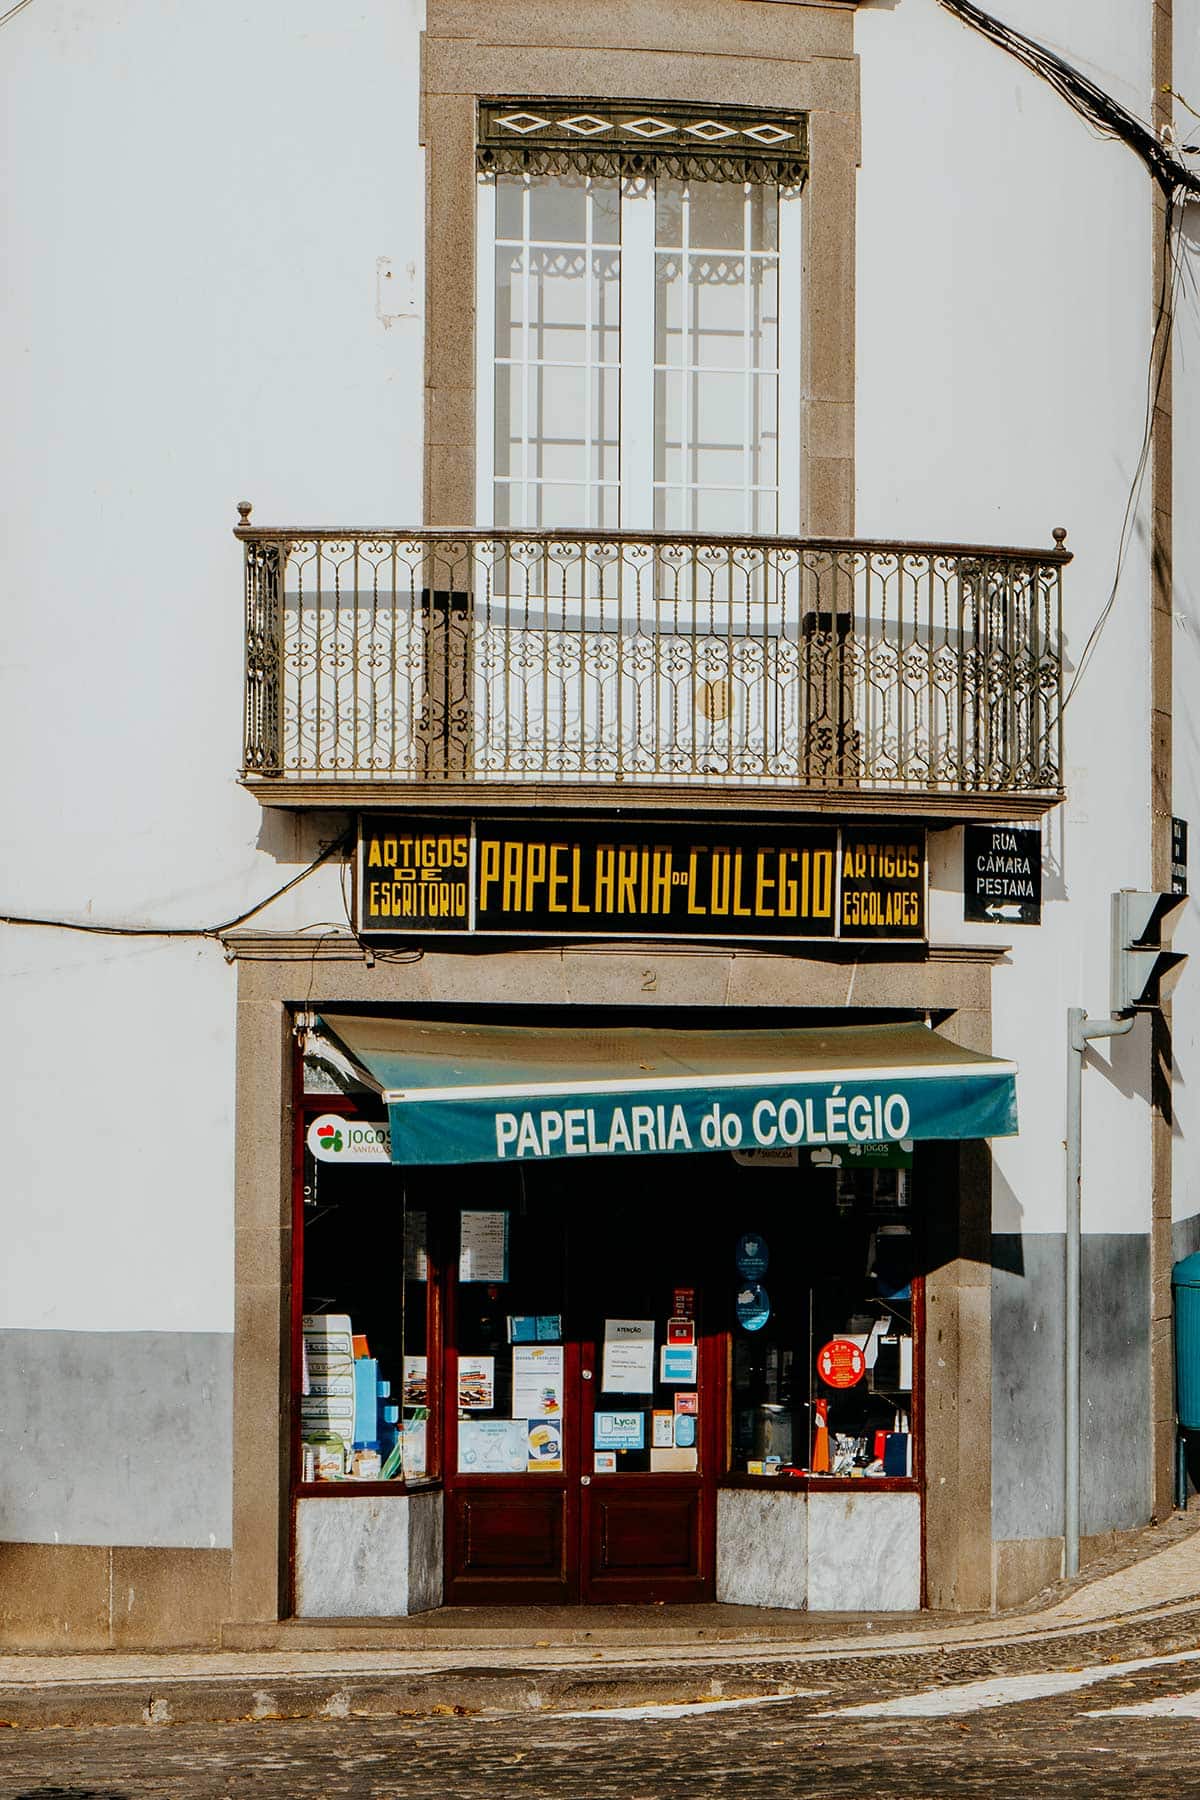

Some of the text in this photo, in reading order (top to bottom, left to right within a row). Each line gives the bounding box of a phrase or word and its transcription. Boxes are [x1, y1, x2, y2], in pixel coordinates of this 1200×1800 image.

[367, 834, 468, 868] ARTIGOS
[992, 833, 1018, 852] RUA
[842, 844, 920, 879] ARTIGOS
[976, 851, 1032, 875] CÂMARA
[394, 868, 443, 881] DE
[479, 840, 834, 918] PAPELARIA DO COLEGIO
[976, 878, 1035, 898] PESTANA
[369, 882, 466, 917] ESCRITORIO
[843, 891, 919, 926] ESCOLARES
[640, 970, 657, 992] 2
[495, 1085, 911, 1159] PAPELARIA do COLÉGIO
[347, 1129, 392, 1149] JOGOS
[863, 1143, 889, 1153] JOGOS
[616, 1326, 642, 1334] ATENÇÃO
[614, 1416, 637, 1426] Lyca
